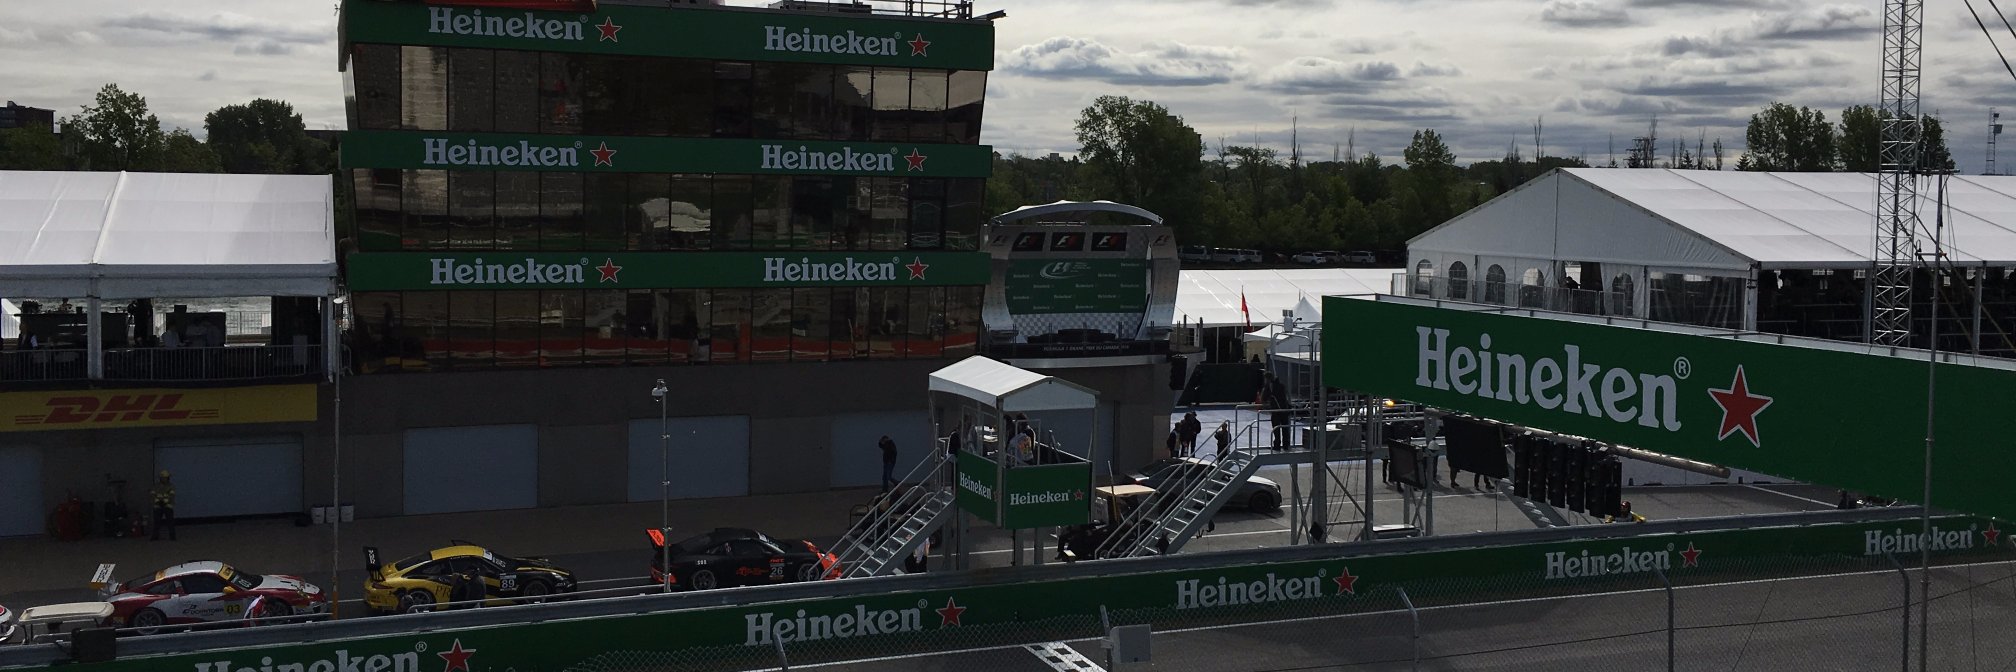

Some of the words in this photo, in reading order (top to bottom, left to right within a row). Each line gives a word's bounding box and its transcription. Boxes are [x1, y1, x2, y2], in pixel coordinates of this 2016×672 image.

[429, 7, 584, 41] Heineken
[765, 26, 898, 56] Heineken
[424, 139, 578, 167] Heineken
[761, 145, 895, 172] Heineken
[431, 258, 585, 285] Heineken
[764, 257, 897, 281] Heineken
[1415, 326, 1681, 431] Heineken
[43, 394, 192, 424] DHL
[960, 472, 992, 500] Heineken
[1009, 491, 1069, 506] Heineken
[1545, 547, 1671, 579] Heineken
[502, 579, 515, 588] 89
[1175, 573, 1323, 610] Heineken
[744, 604, 923, 646] Heineken
